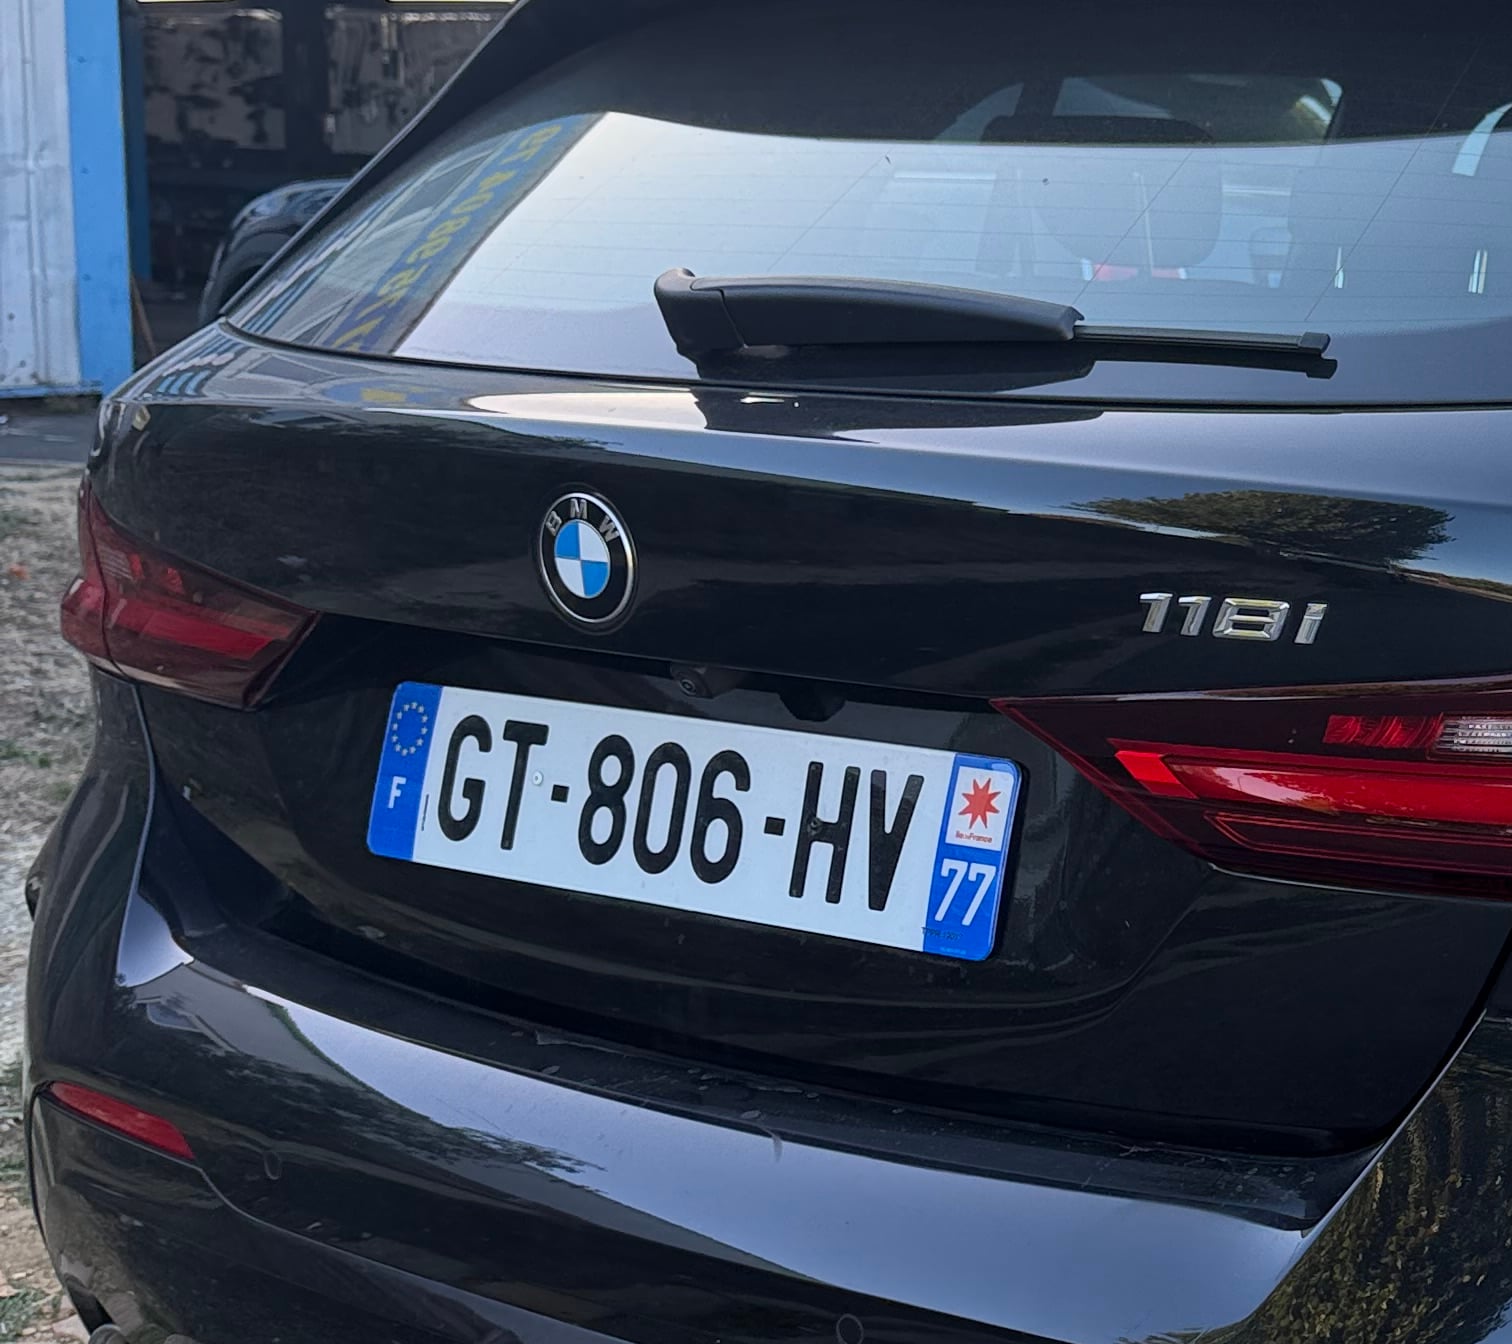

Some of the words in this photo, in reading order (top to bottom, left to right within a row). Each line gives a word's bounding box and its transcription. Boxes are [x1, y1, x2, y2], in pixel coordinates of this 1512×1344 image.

[546, 498, 620, 543] BMW
[1139, 592, 1328, 645] 118i
[387, 775, 408, 809] F
[437, 714, 925, 911] GT-806-HV
[934, 858, 996, 926] 77
